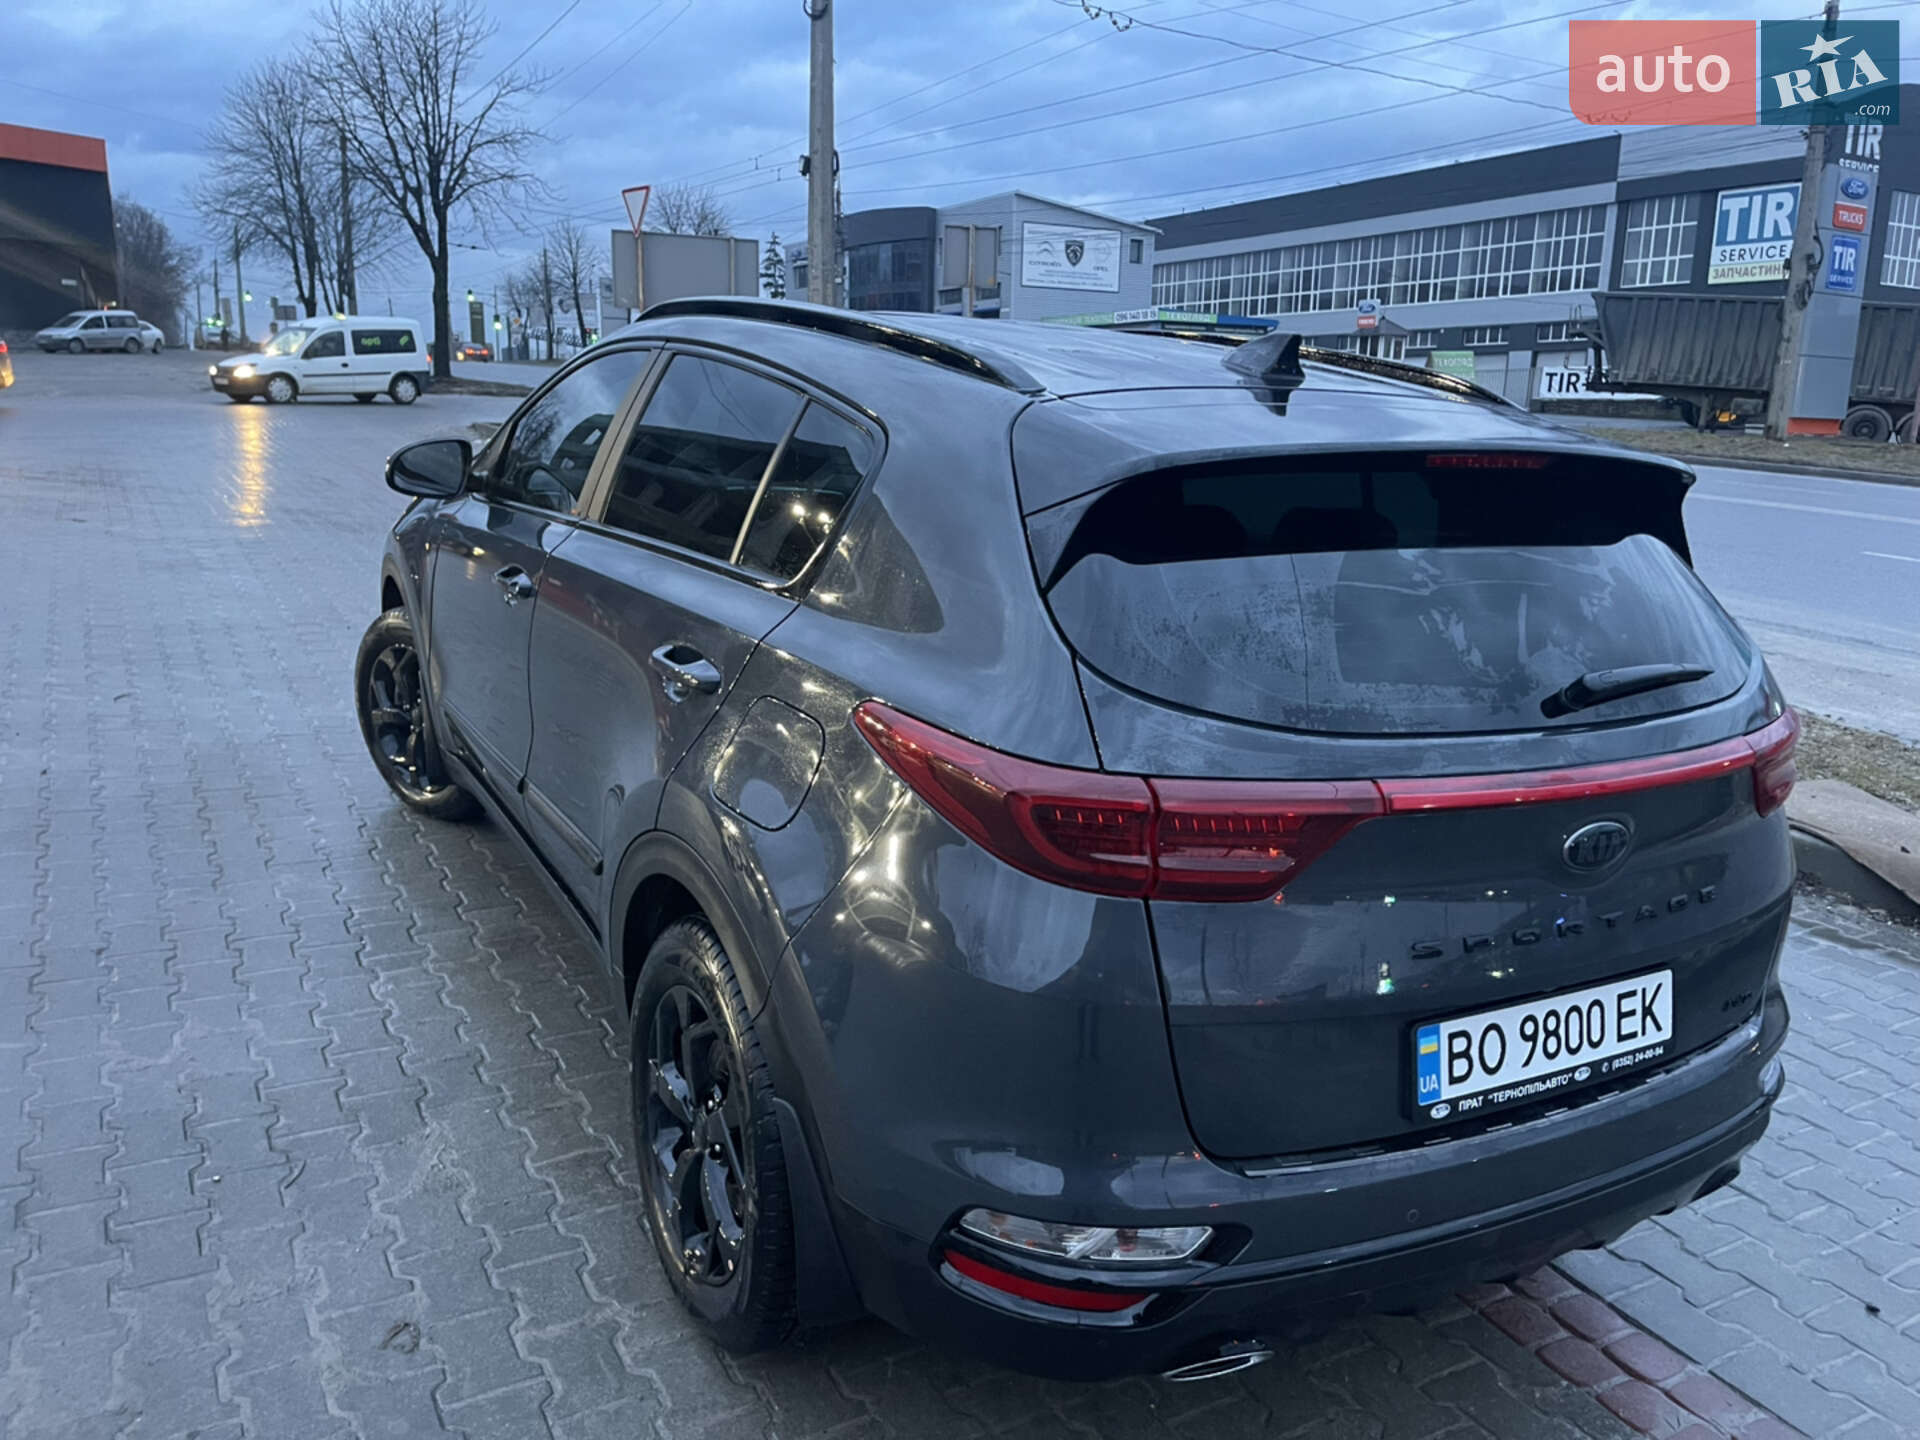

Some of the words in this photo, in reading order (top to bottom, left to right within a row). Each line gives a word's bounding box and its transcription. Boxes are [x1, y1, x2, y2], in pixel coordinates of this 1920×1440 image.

[1844, 113, 1884, 160] TIR
[1722, 192, 1794, 242] TIR
[1838, 209, 1864, 225] TRUCKS
[1719, 244, 1788, 263] SERVICE
[1832, 245, 1857, 272] TIR
[1411, 885, 1716, 960] SPORTAGE
[1448, 1022, 1506, 1085] BO
[1519, 999, 1606, 1068] 9800
[1616, 982, 1664, 1043] EK
[1419, 1074, 1439, 1094] UA
[1458, 1095, 1484, 1112] ПРАТ
